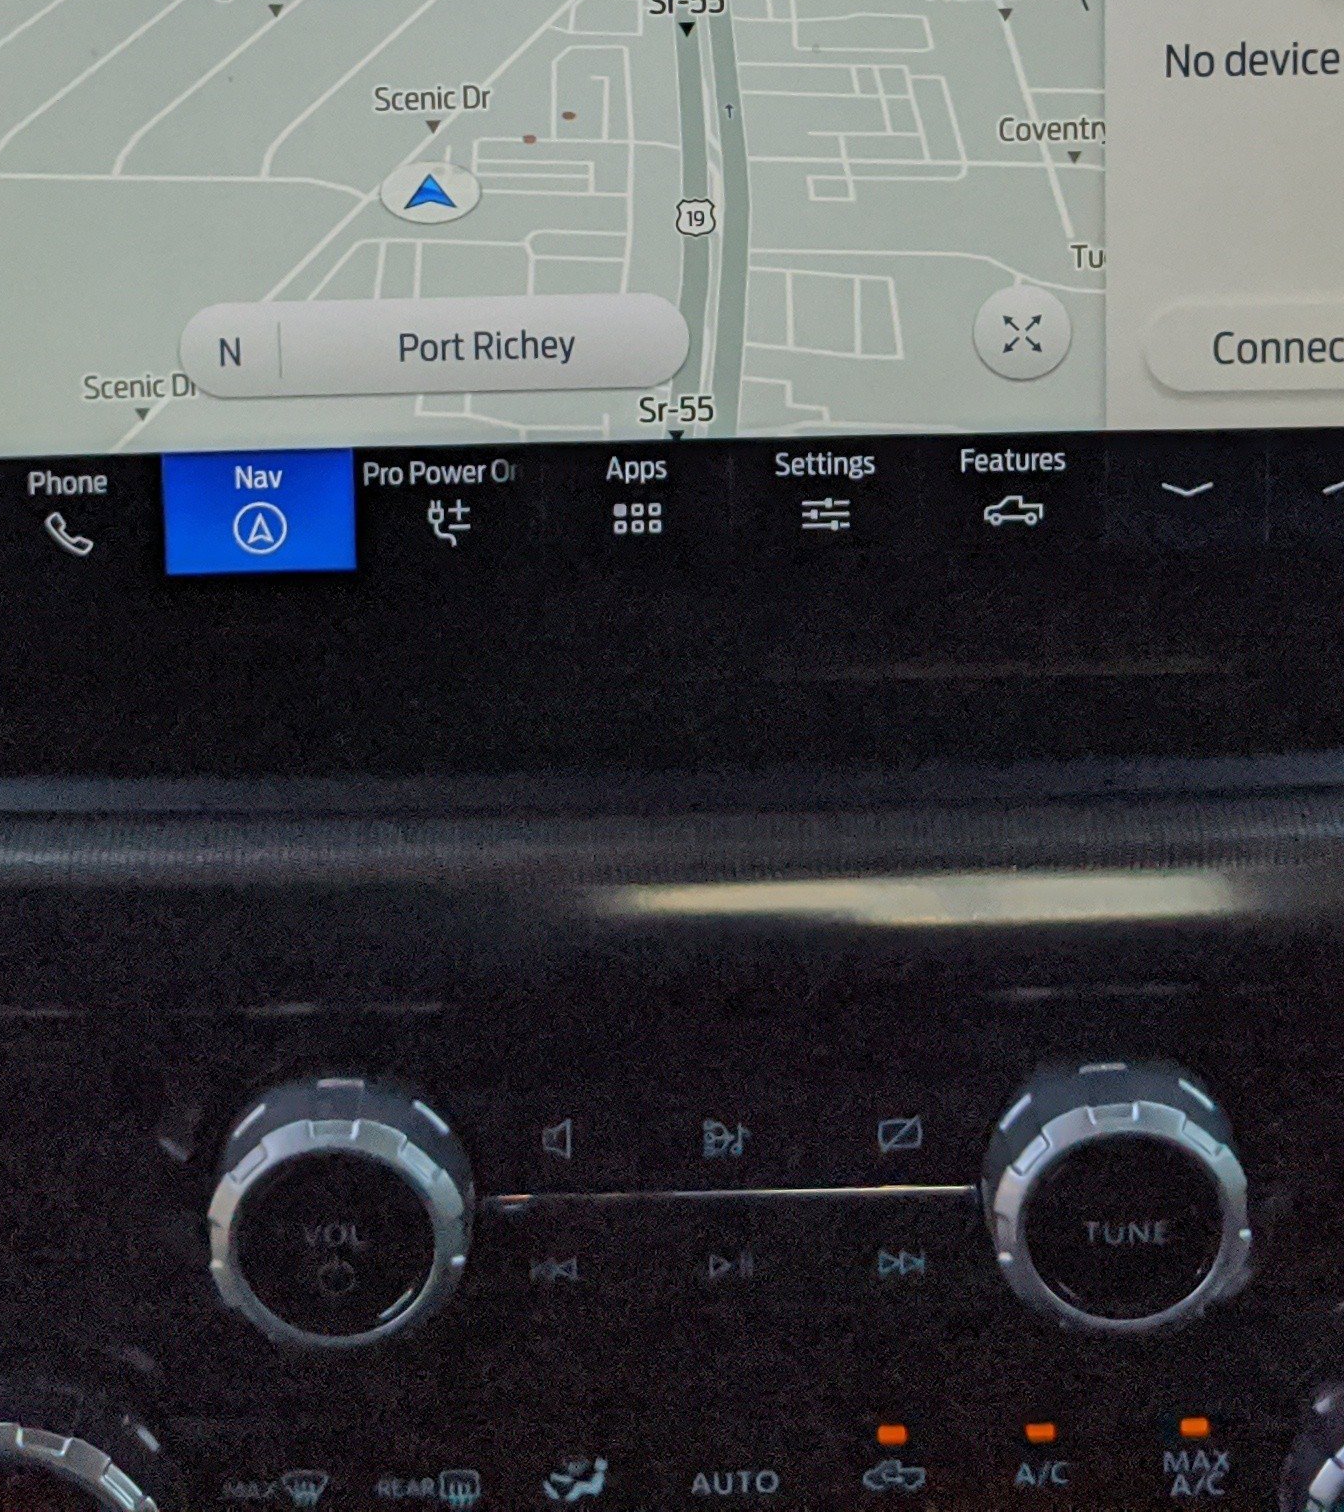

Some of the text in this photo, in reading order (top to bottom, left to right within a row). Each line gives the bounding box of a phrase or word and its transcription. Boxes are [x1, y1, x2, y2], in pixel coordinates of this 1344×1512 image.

[1164, 43, 1215, 78] No
[1225, 41, 1341, 77] device
[374, 86, 491, 113] Scenic Dr
[685, 209, 705, 228] 19
[1070, 244, 1104, 269] Tu
[220, 336, 242, 367] N
[399, 329, 576, 365] Port Richey
[83, 374, 165, 401] Scenic
[639, 396, 715, 424] Sr-55
[363, 462, 404, 486] Pro
[410, 461, 486, 485] Power
[607, 456, 668, 484] Apps
[775, 452, 876, 478] Settings
[960, 448, 1067, 474] Features
[29, 471, 108, 495] Phone
[235, 466, 283, 490] Nav
[303, 1222, 367, 1252] VOL
[1086, 1221, 1170, 1247] TUNE
[1016, 1461, 1070, 1487] A/C
[1163, 1451, 1230, 1474] MAX
[691, 1471, 781, 1496] AUTO
[1170, 1472, 1226, 1498] A/C
